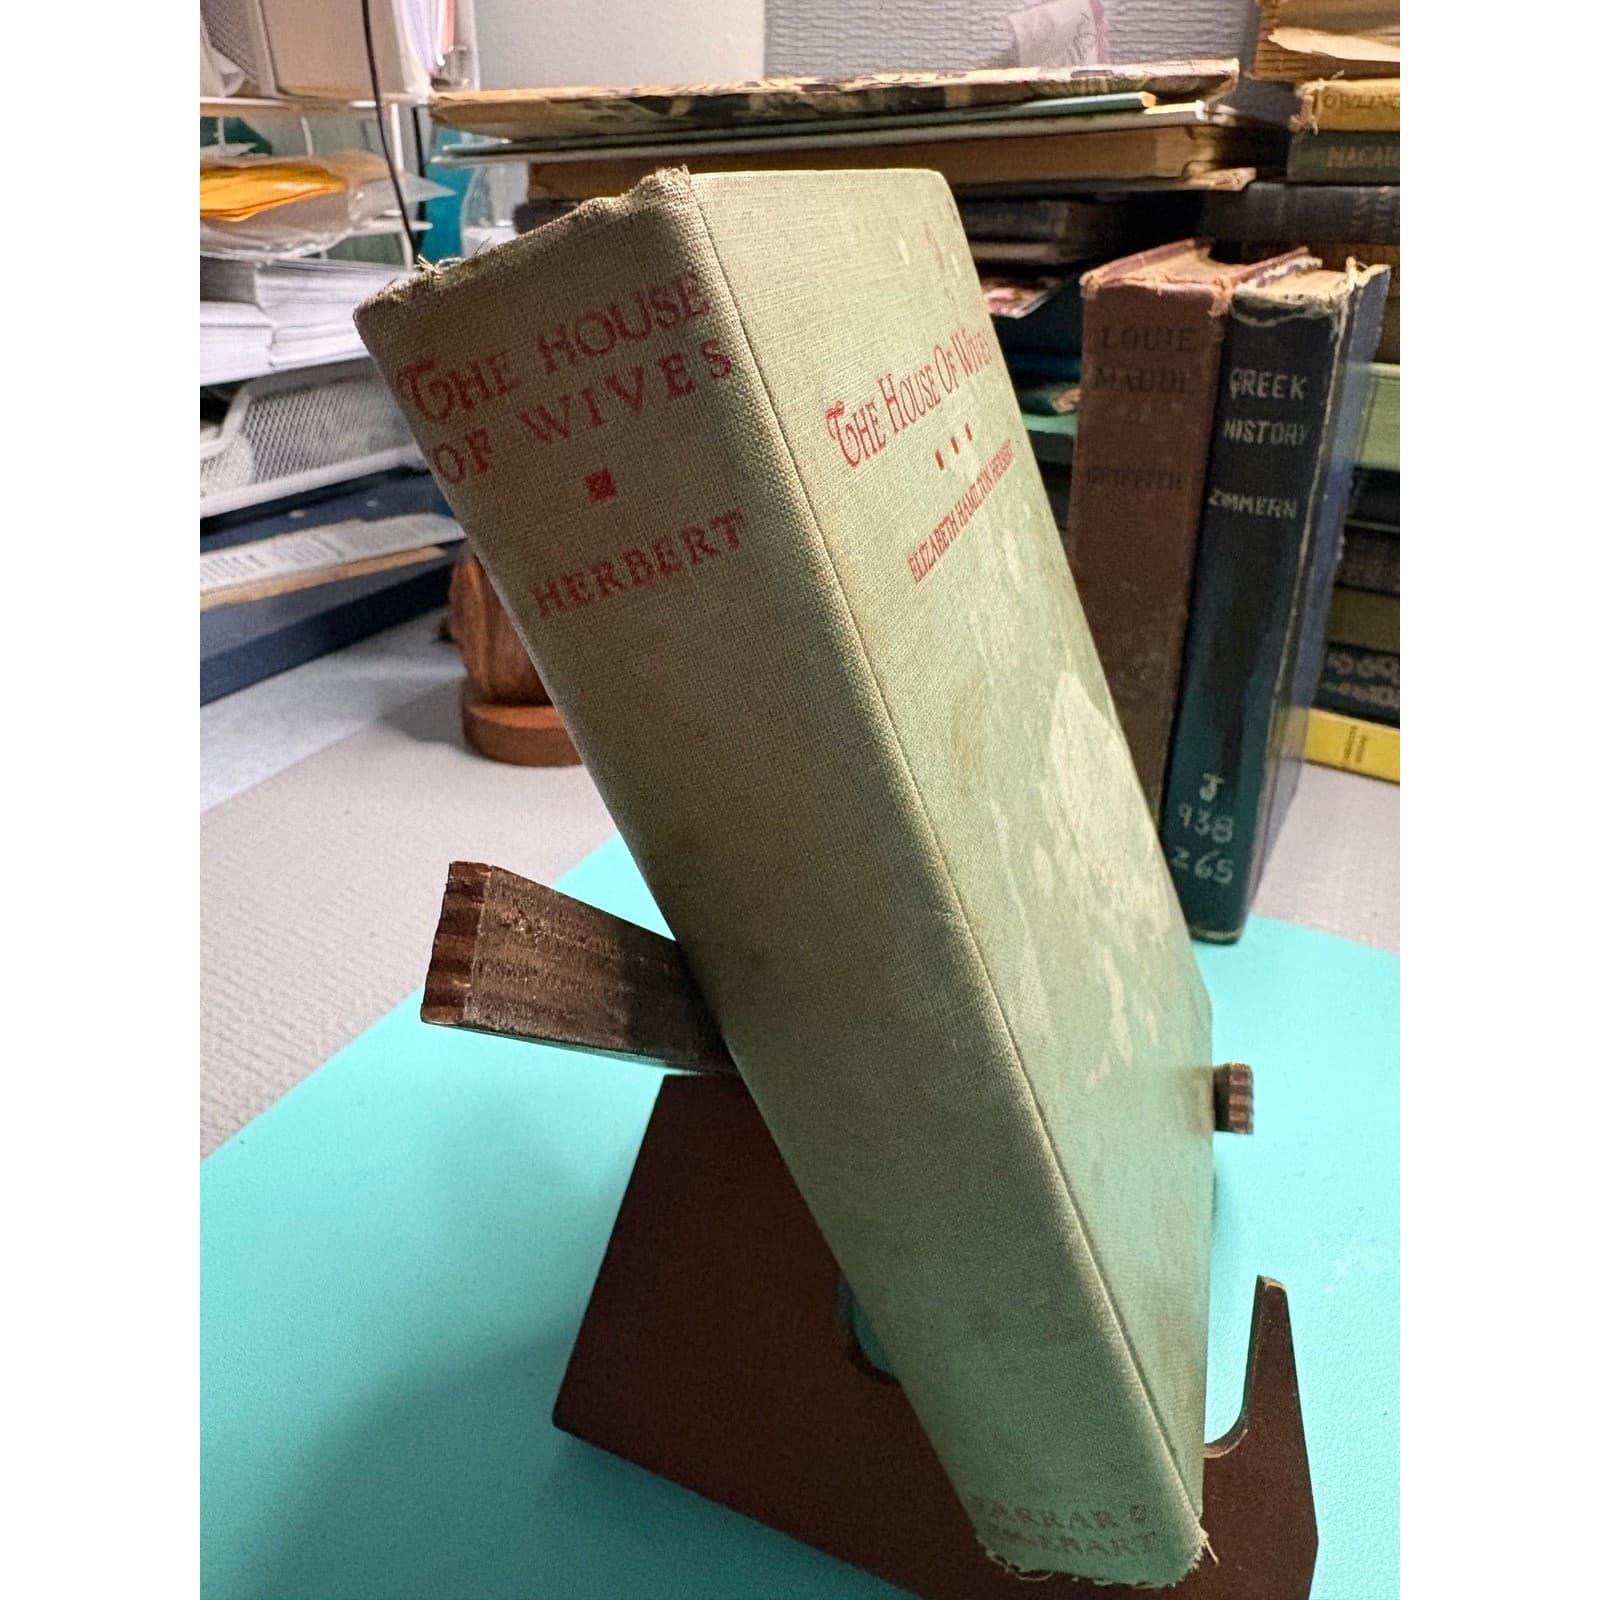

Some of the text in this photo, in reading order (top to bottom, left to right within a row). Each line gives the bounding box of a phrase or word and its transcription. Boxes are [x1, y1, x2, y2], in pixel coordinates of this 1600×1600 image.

[394, 272, 710, 423] THE HOUSE
[1229, 367, 1307, 399] GREEK
[432, 340, 733, 484] OF WIVES
[825, 401, 887, 468] THE
[878, 365, 942, 434] HOUSE
[933, 344, 959, 394] OF
[1223, 417, 1308, 445] HISTORY
[1209, 490, 1297, 518] ZIMMERN
[531, 510, 744, 618] HERBERT
[1179, 803, 1234, 843] 938
